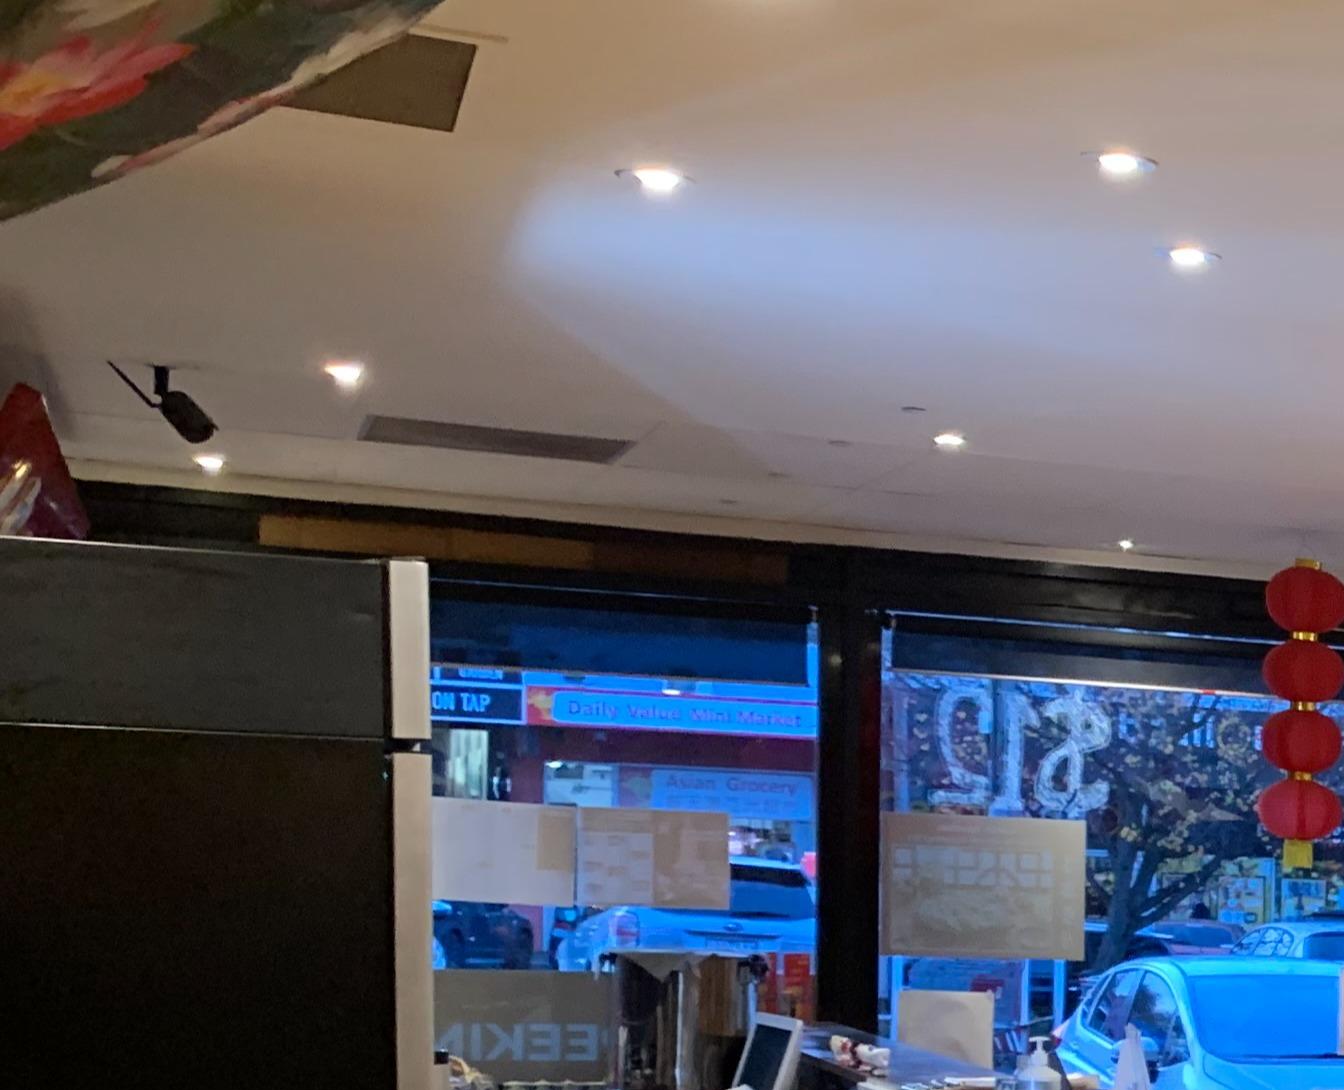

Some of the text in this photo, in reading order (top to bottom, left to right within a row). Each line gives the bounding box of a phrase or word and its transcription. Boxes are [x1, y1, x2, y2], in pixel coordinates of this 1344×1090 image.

[432, 691, 491, 713] ON TAP
[568, 700, 617, 719] Daily
[627, 704, 682, 721] Value
[667, 774, 798, 797] Asian Grocery
